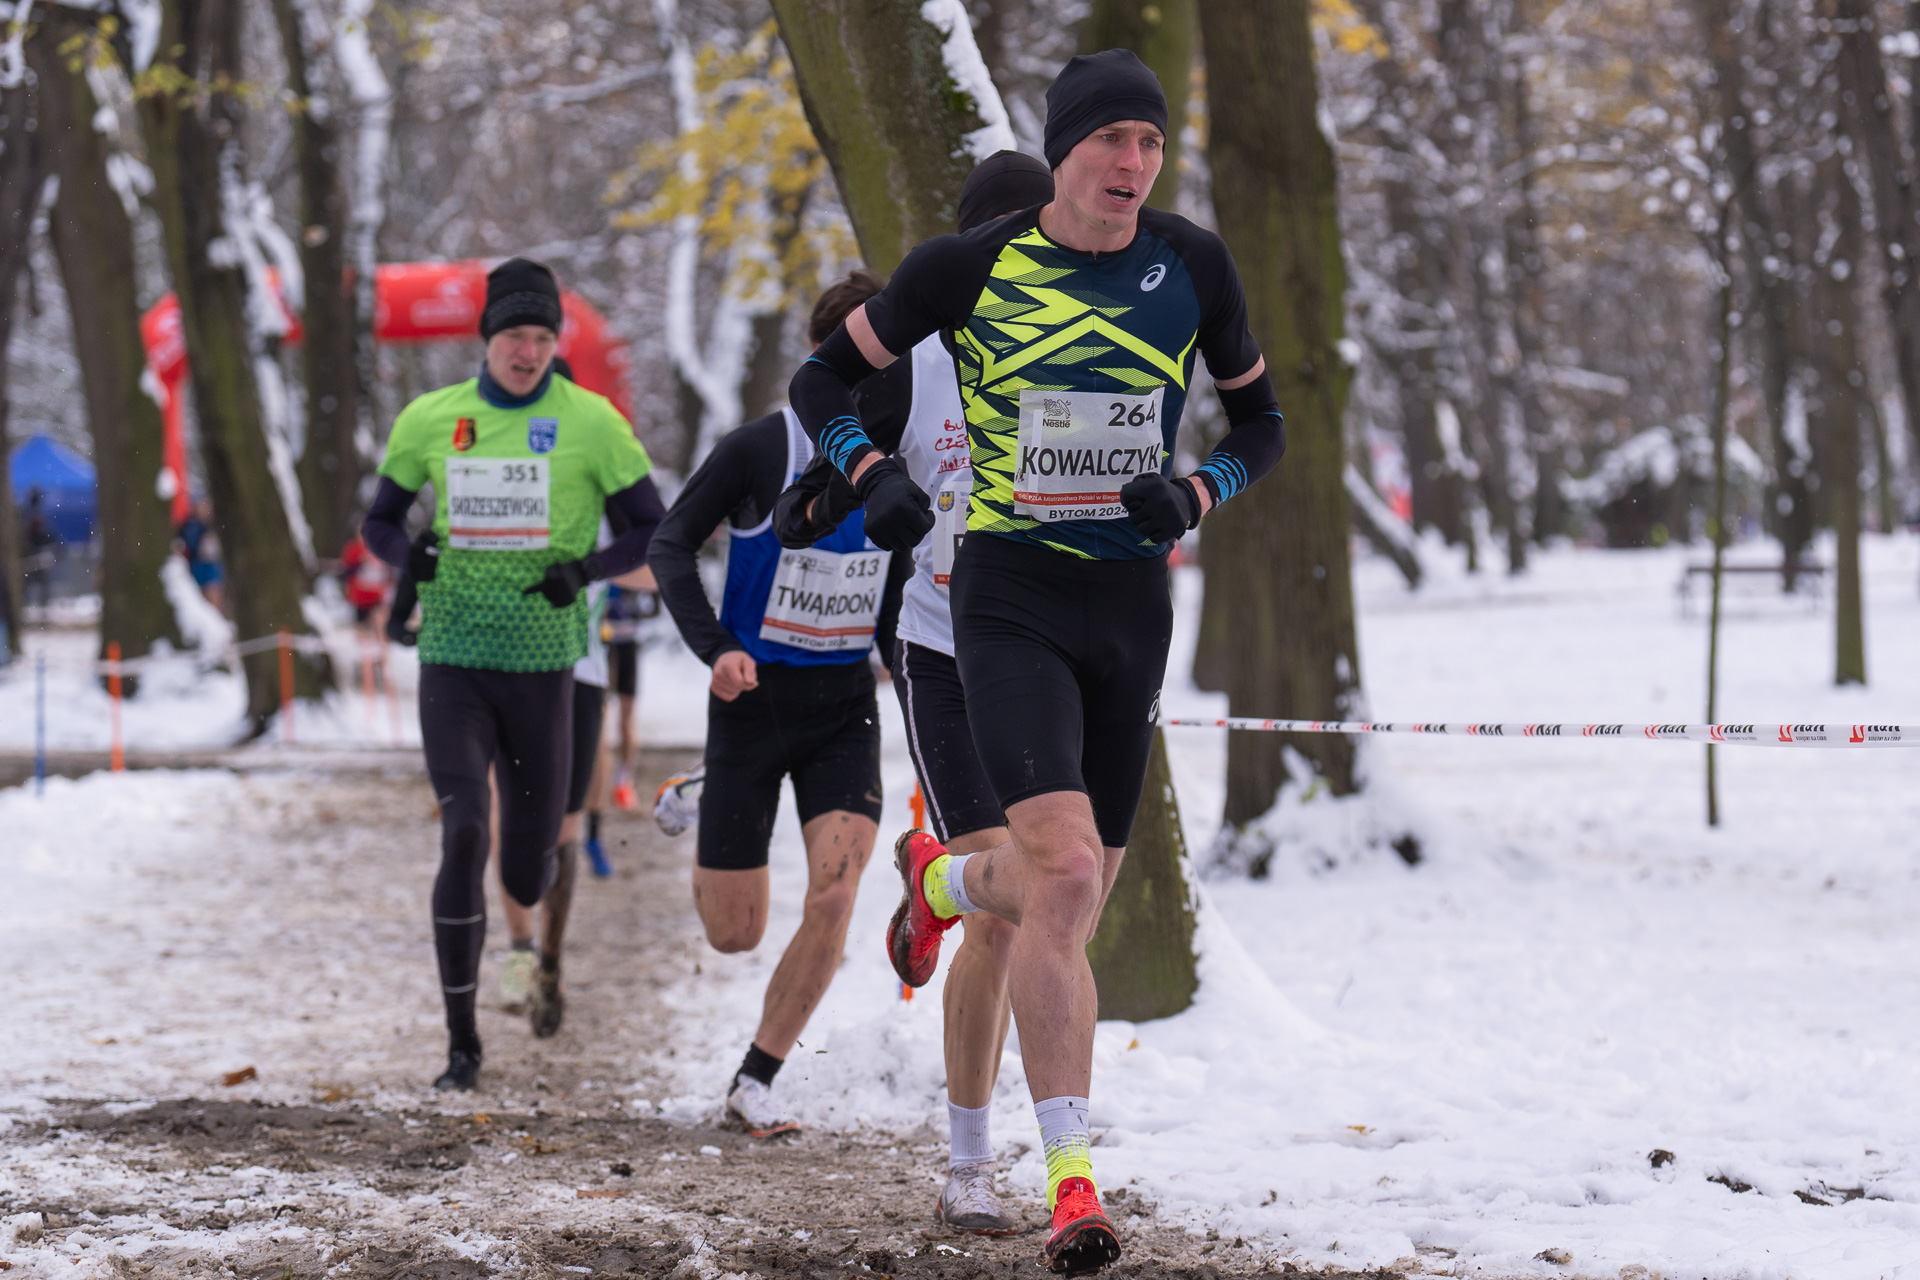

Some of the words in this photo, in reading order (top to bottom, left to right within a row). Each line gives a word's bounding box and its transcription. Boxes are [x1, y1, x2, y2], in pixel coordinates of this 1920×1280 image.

[1108, 400, 1156, 427] 264
[944, 418, 964, 431] BU
[1022, 442, 1160, 476] KOWALCZYK
[503, 464, 538, 482] 351
[1043, 494, 1077, 502] Mistrzostwa
[1079, 493, 1095, 501] Polski
[1102, 493, 1120, 501] Biega
[1049, 508, 1096, 519] BYTOM
[1099, 506, 1128, 517] 2024
[845, 557, 880, 578] 613
[778, 586, 877, 616] TWARDOŃ
